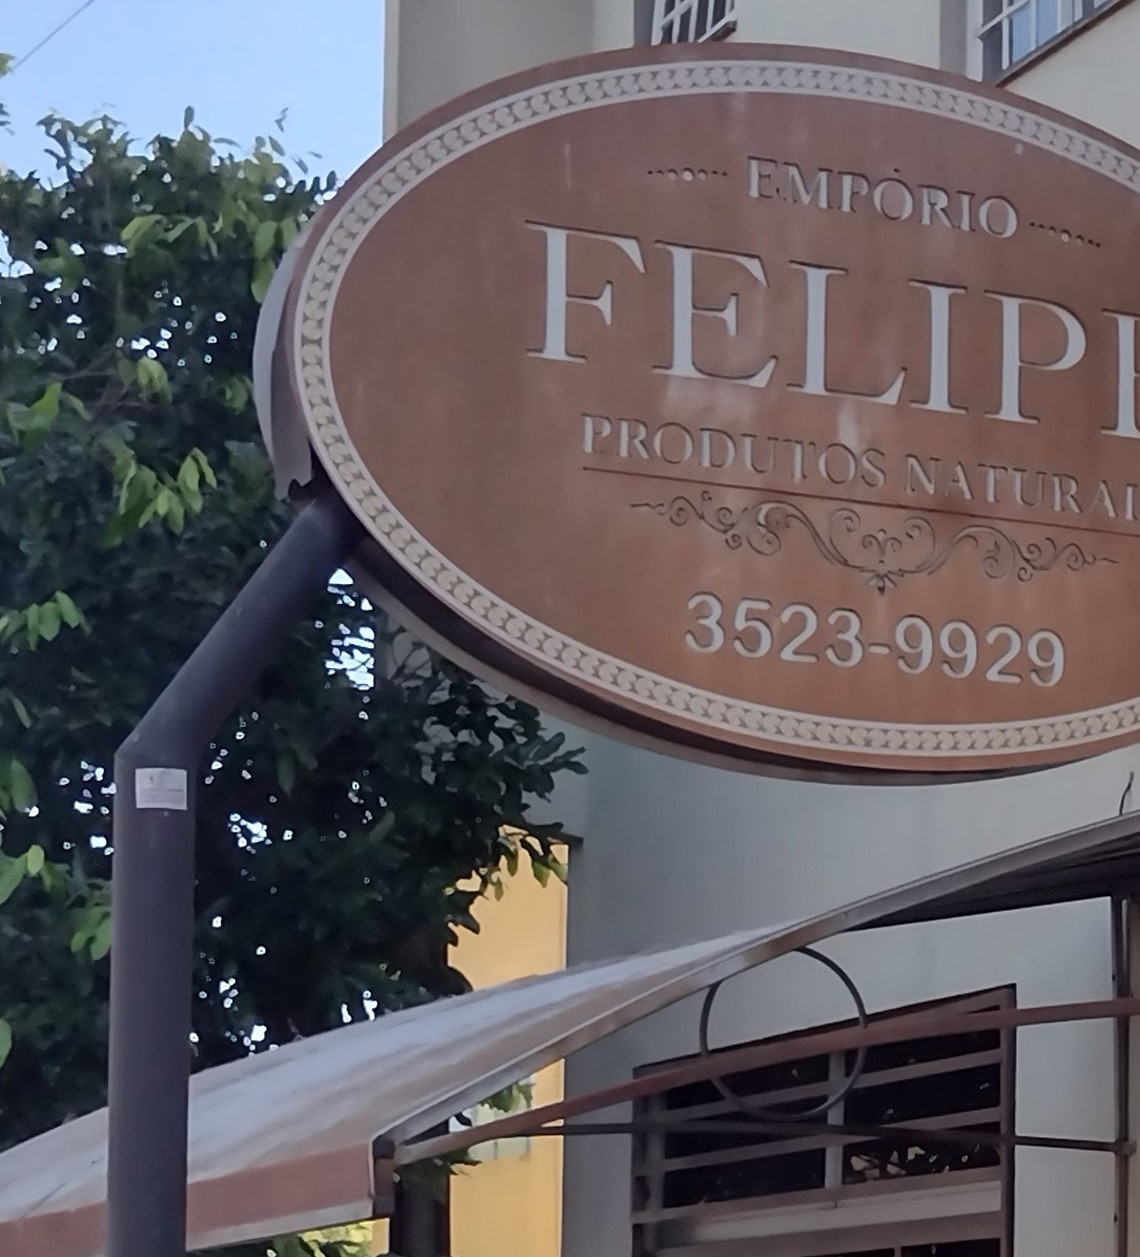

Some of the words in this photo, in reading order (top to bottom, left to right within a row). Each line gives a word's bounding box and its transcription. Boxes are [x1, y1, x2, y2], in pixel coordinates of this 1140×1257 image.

[746, 155, 1019, 239] EMPÓRIO
[580, 412, 888, 489] PRODUTOS
[685, 592, 1066, 688] 3523-9929
